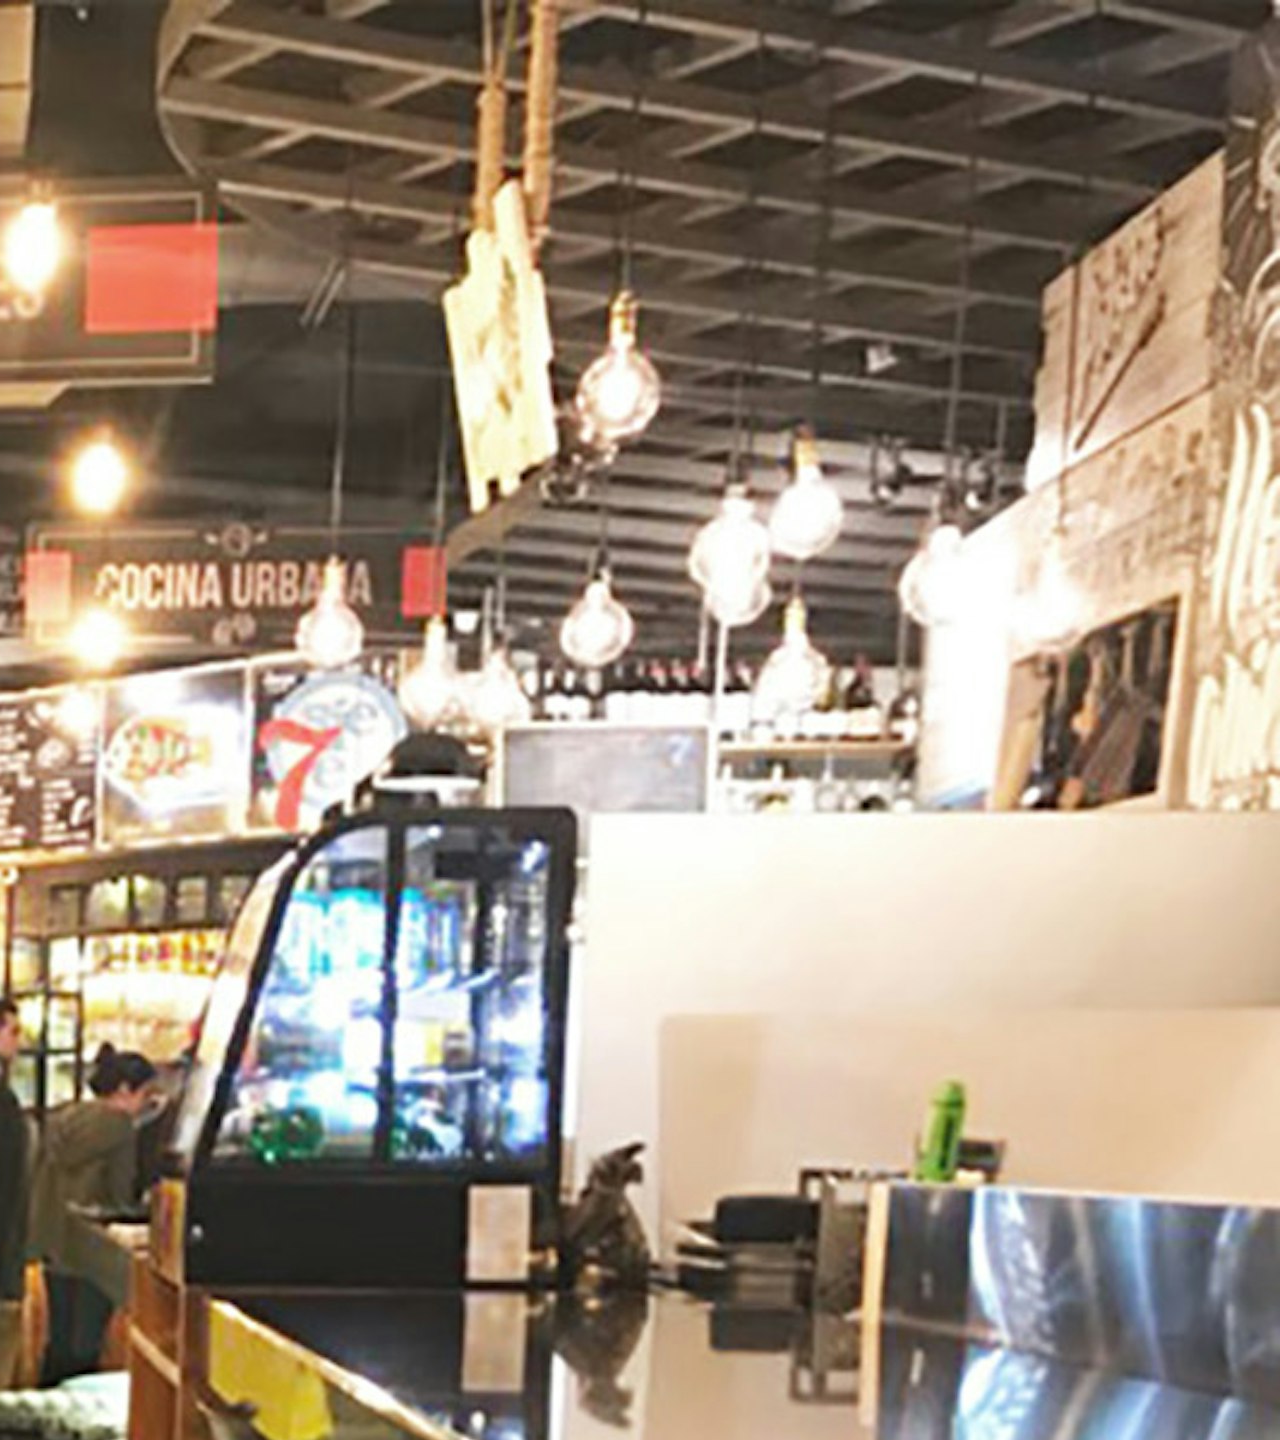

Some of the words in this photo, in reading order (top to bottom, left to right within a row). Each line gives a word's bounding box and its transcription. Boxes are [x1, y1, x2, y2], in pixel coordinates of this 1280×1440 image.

[93, 562, 222, 610] COCINA
[231, 560, 372, 608] URBAA
[258, 718, 343, 833] 7
